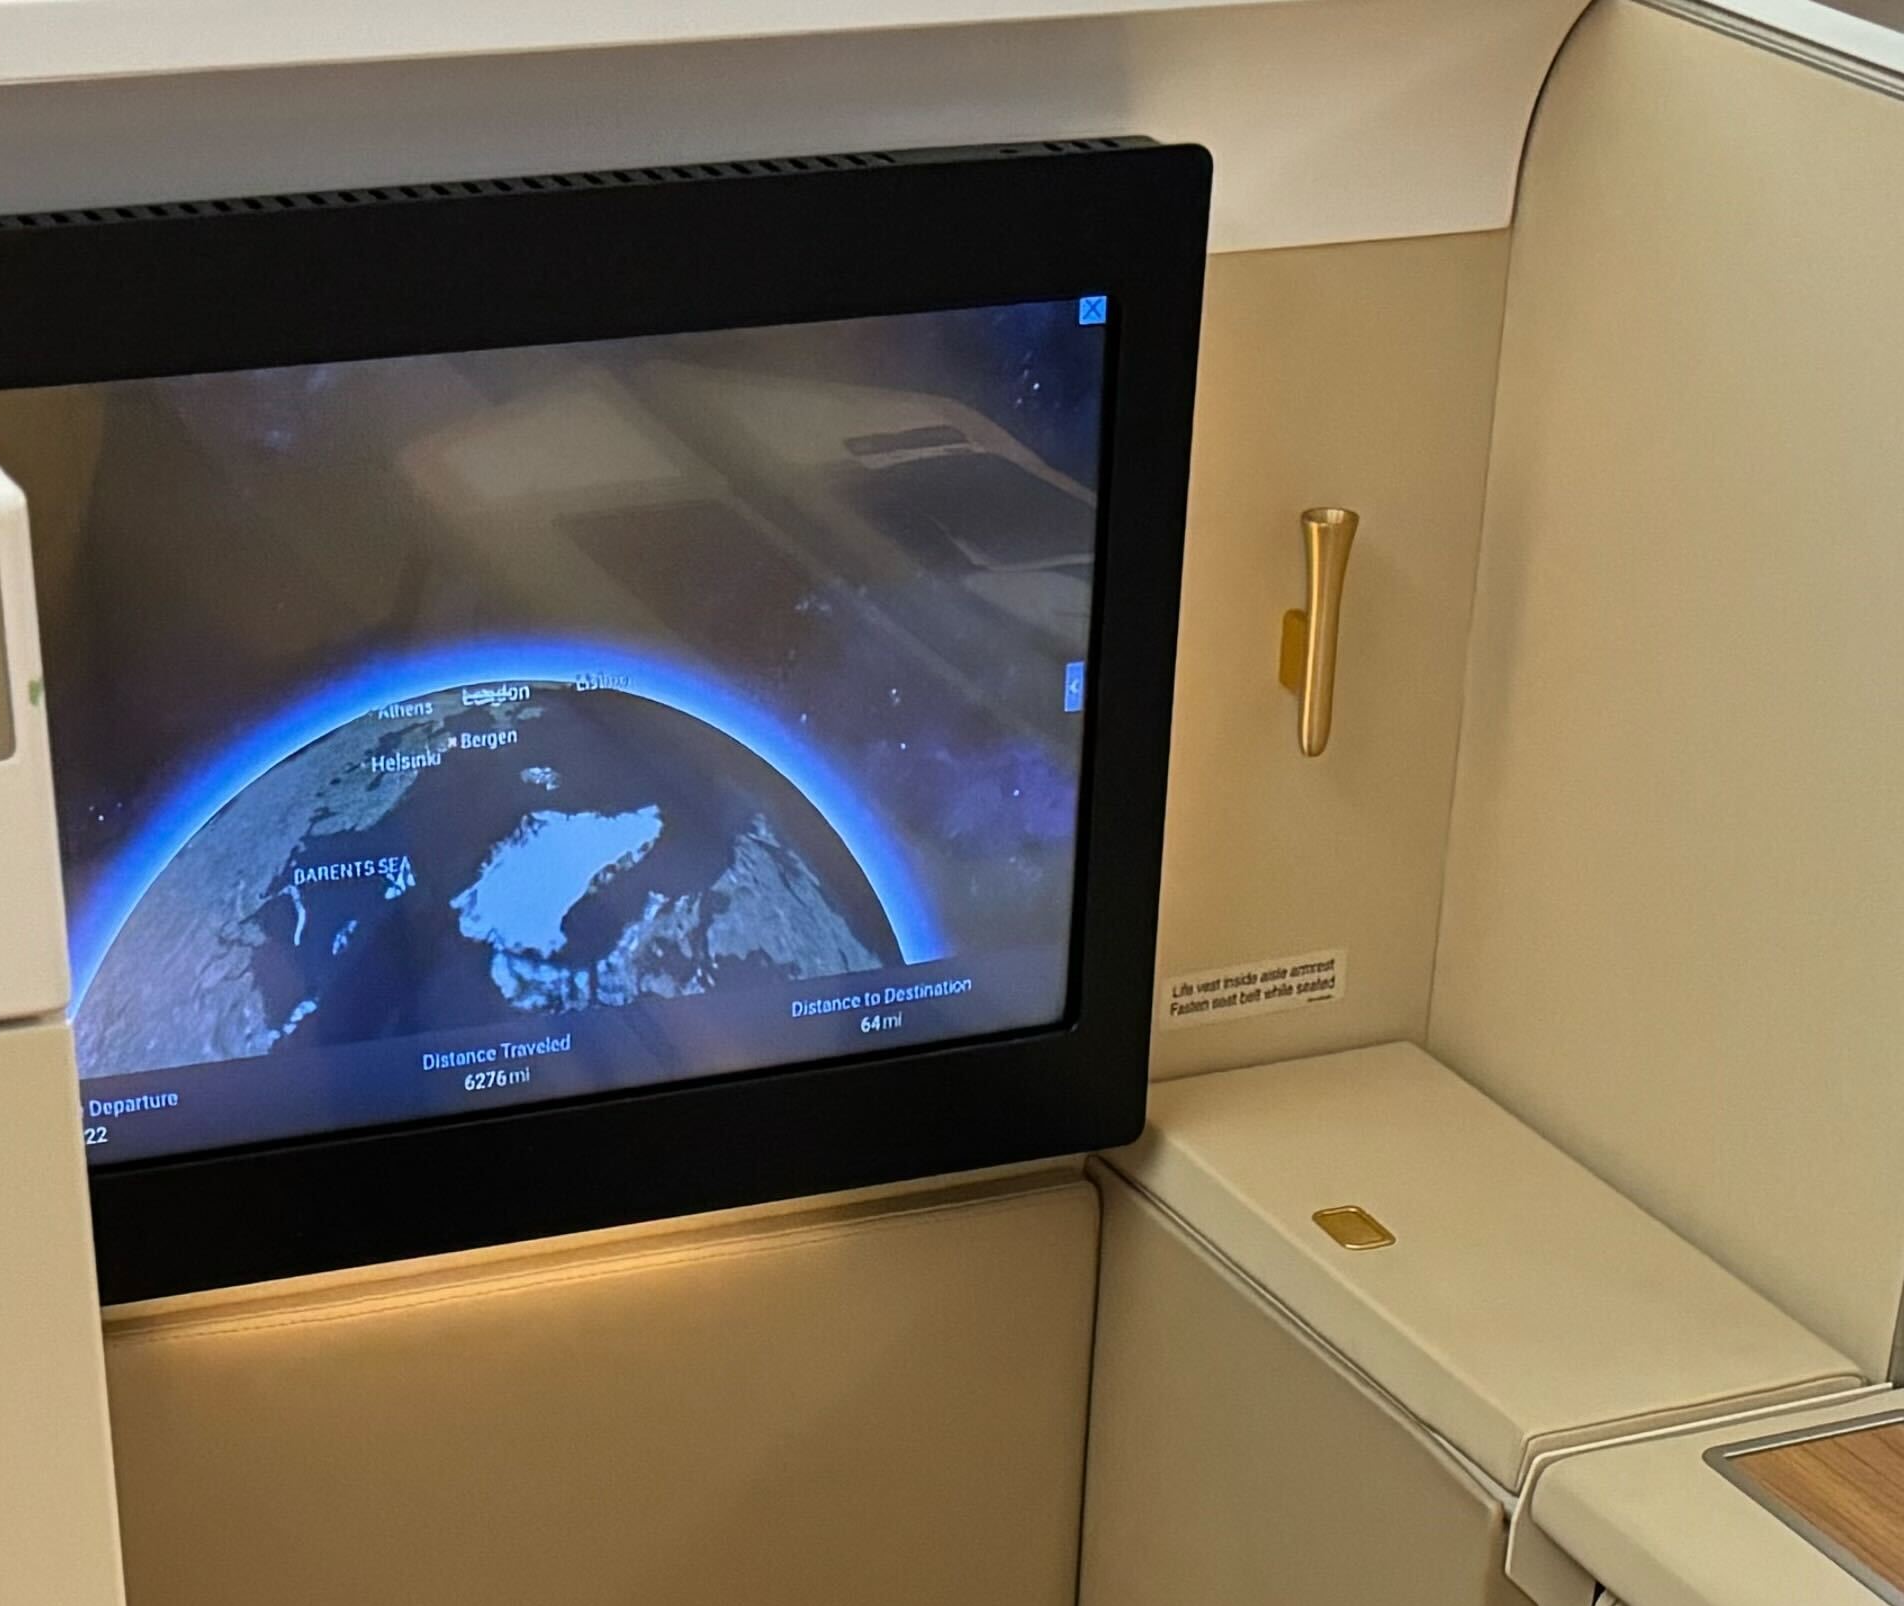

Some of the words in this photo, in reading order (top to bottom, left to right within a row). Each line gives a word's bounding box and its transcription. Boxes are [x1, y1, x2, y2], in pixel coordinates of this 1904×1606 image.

[460, 729, 518, 751] Bergen
[371, 749, 442, 773] Helsinki
[294, 860, 375, 886] BARENTS
[792, 995, 861, 1017] Distance
[864, 992, 880, 1008] to
[884, 978, 972, 1004] Destination
[423, 1046, 496, 1071] Distance
[501, 1033, 572, 1059] Traveled
[89, 1093, 179, 1118] Departure
